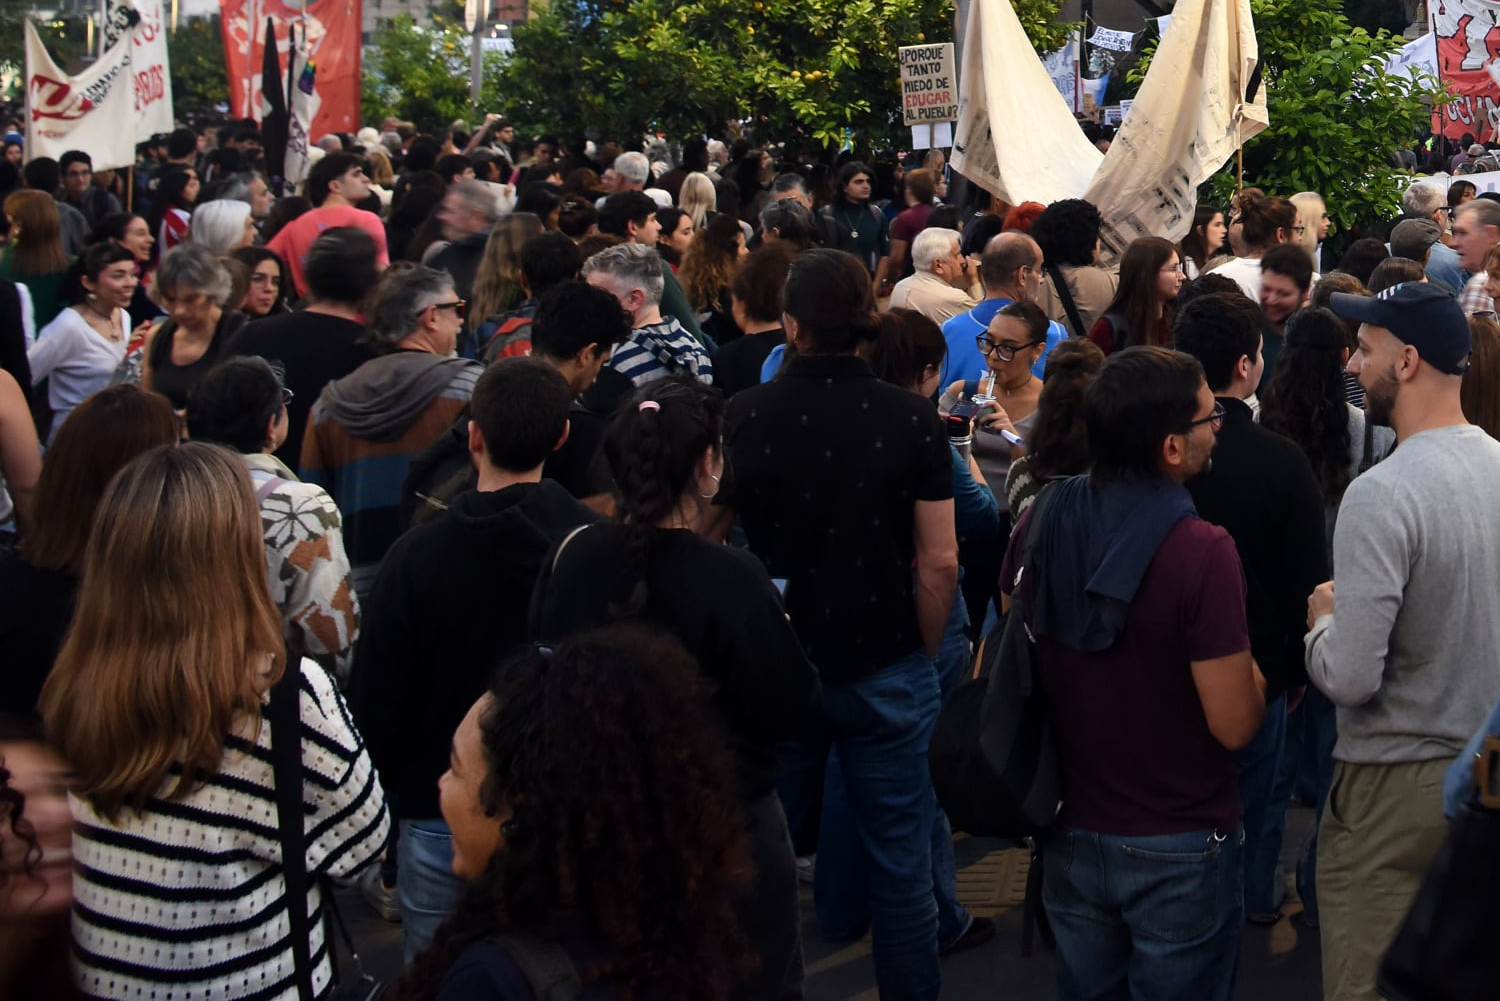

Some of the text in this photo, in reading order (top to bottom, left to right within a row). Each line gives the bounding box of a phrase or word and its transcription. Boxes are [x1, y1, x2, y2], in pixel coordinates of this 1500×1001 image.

[906, 62, 941, 77] TANTO
[904, 78, 949, 94] MIEDO DE
[905, 104, 958, 121] AL PUEBLO?
